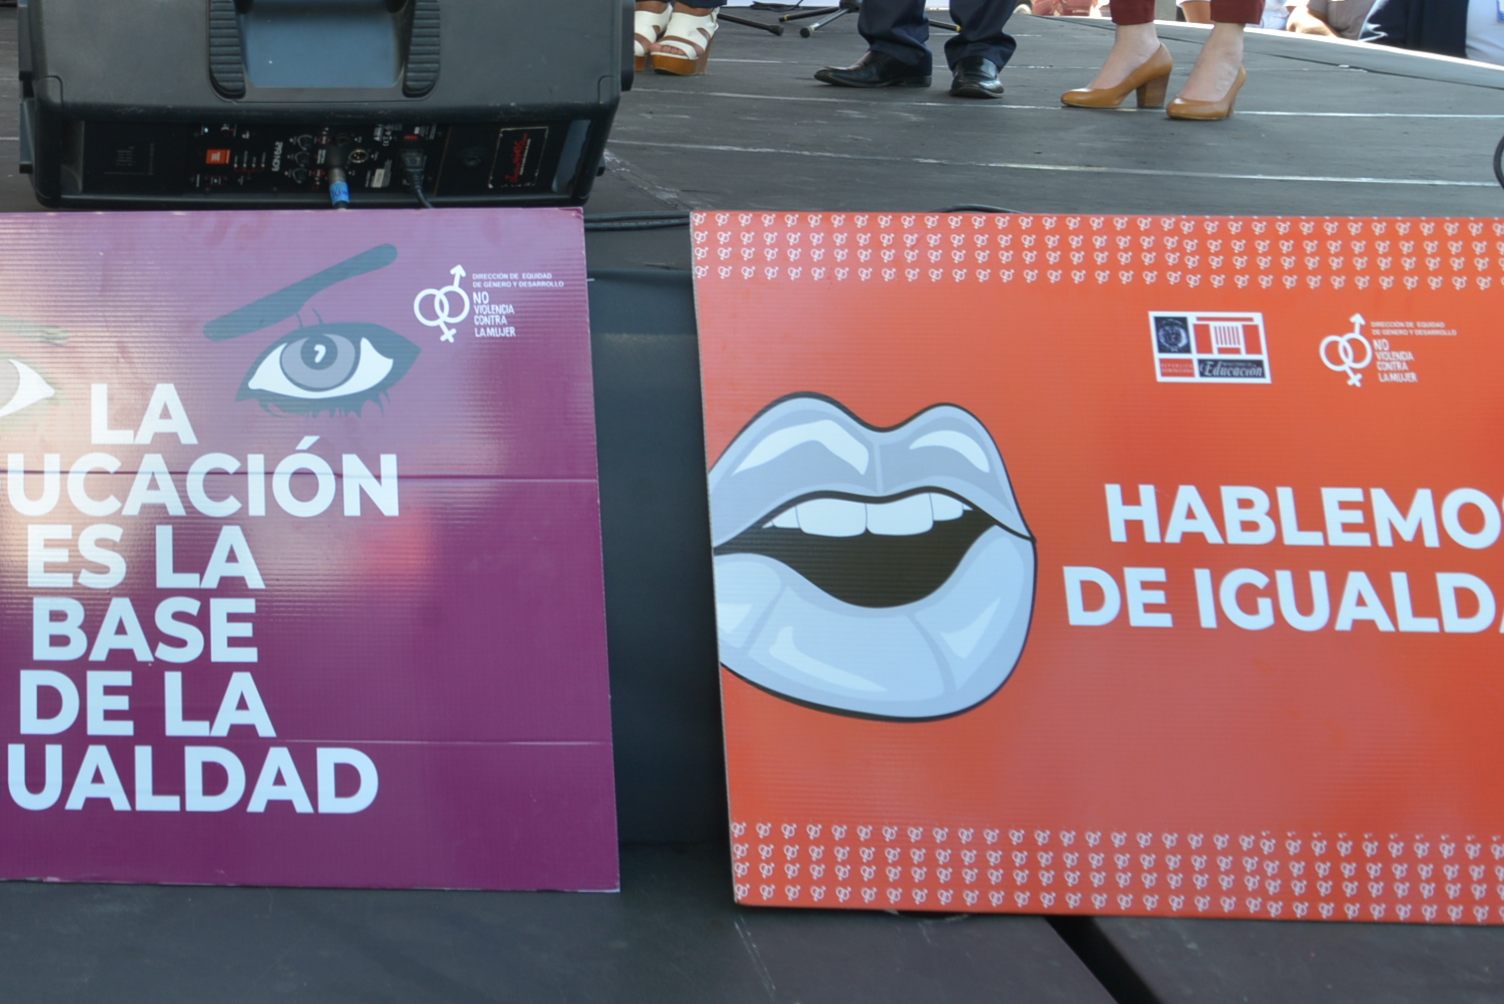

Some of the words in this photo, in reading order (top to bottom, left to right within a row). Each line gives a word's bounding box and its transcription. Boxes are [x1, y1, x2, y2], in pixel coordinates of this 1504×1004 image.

[472, 272, 508, 280] DIRECCIÓN
[473, 292, 489, 304] NO
[474, 304, 515, 314] VIOLENCIA
[474, 315, 507, 325] CONTRA
[1200, 361, 1263, 377] Educación
[89, 383, 199, 445] LA
[1104, 483, 1504, 550] HABLEMO
[26, 523, 127, 590] ES
[155, 524, 267, 589] LA
[32, 596, 259, 663] BASE
[1062, 566, 1174, 628] DE
[1193, 568, 1504, 634] IGUALD
[19, 669, 135, 736] DE
[164, 670, 277, 738] LA
